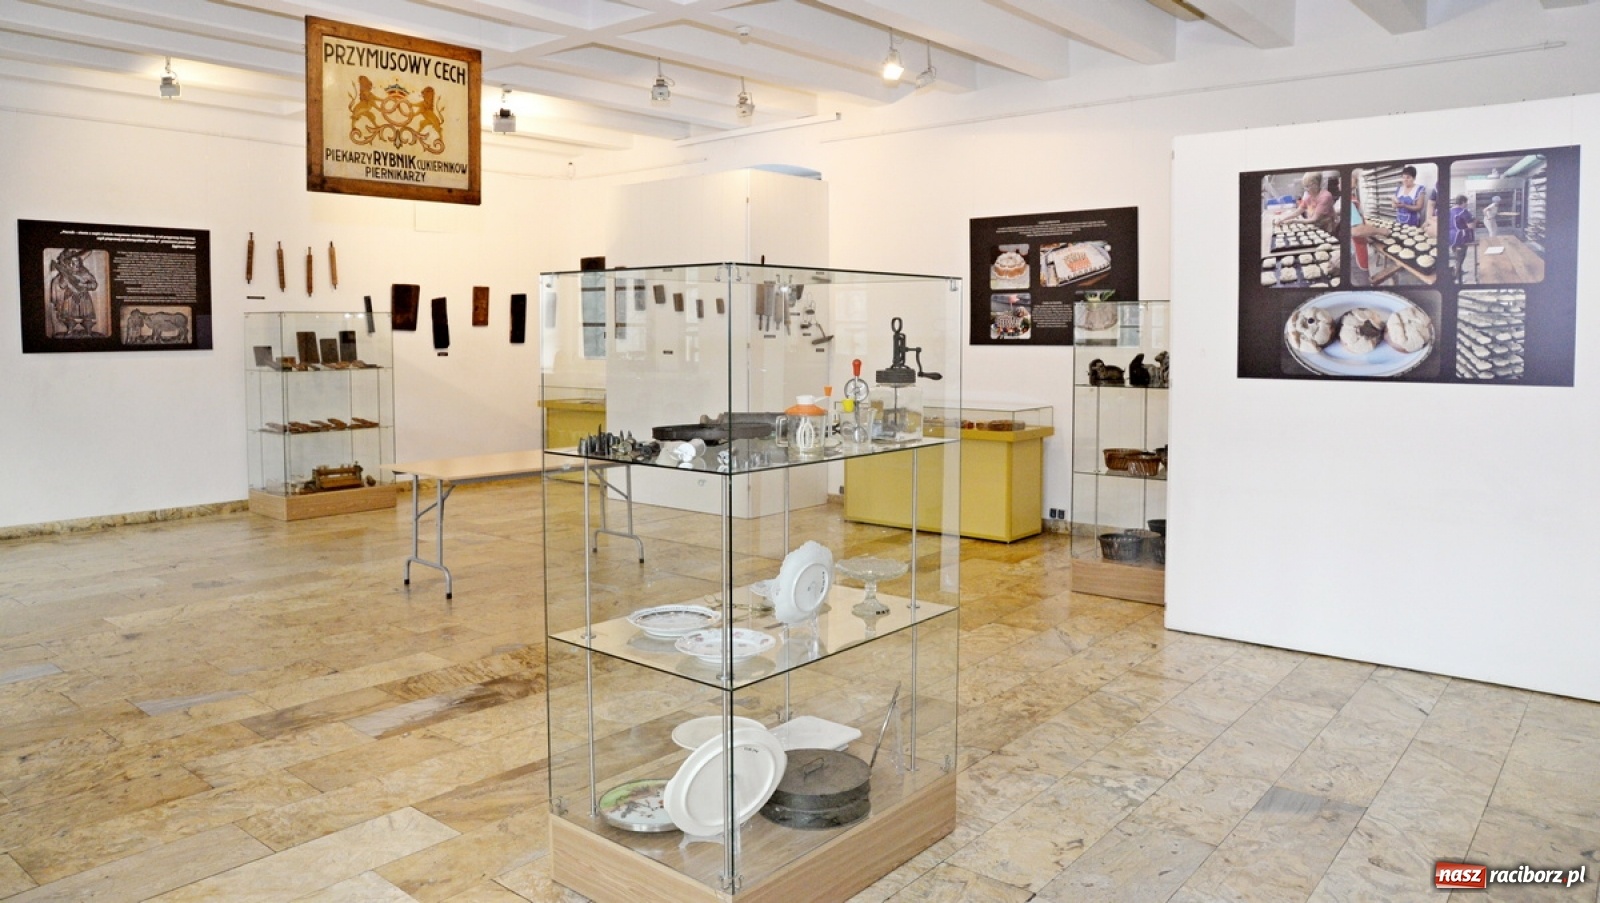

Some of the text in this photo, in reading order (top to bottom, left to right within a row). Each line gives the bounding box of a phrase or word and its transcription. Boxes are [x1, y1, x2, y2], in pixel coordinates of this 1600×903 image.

[324, 42, 466, 86] PRZYMUSOWY CECH
[325, 148, 373, 165] PIEKARZY
[373, 150, 417, 170] RYBNIK
[365, 166, 427, 182] PIERNIKARZY
